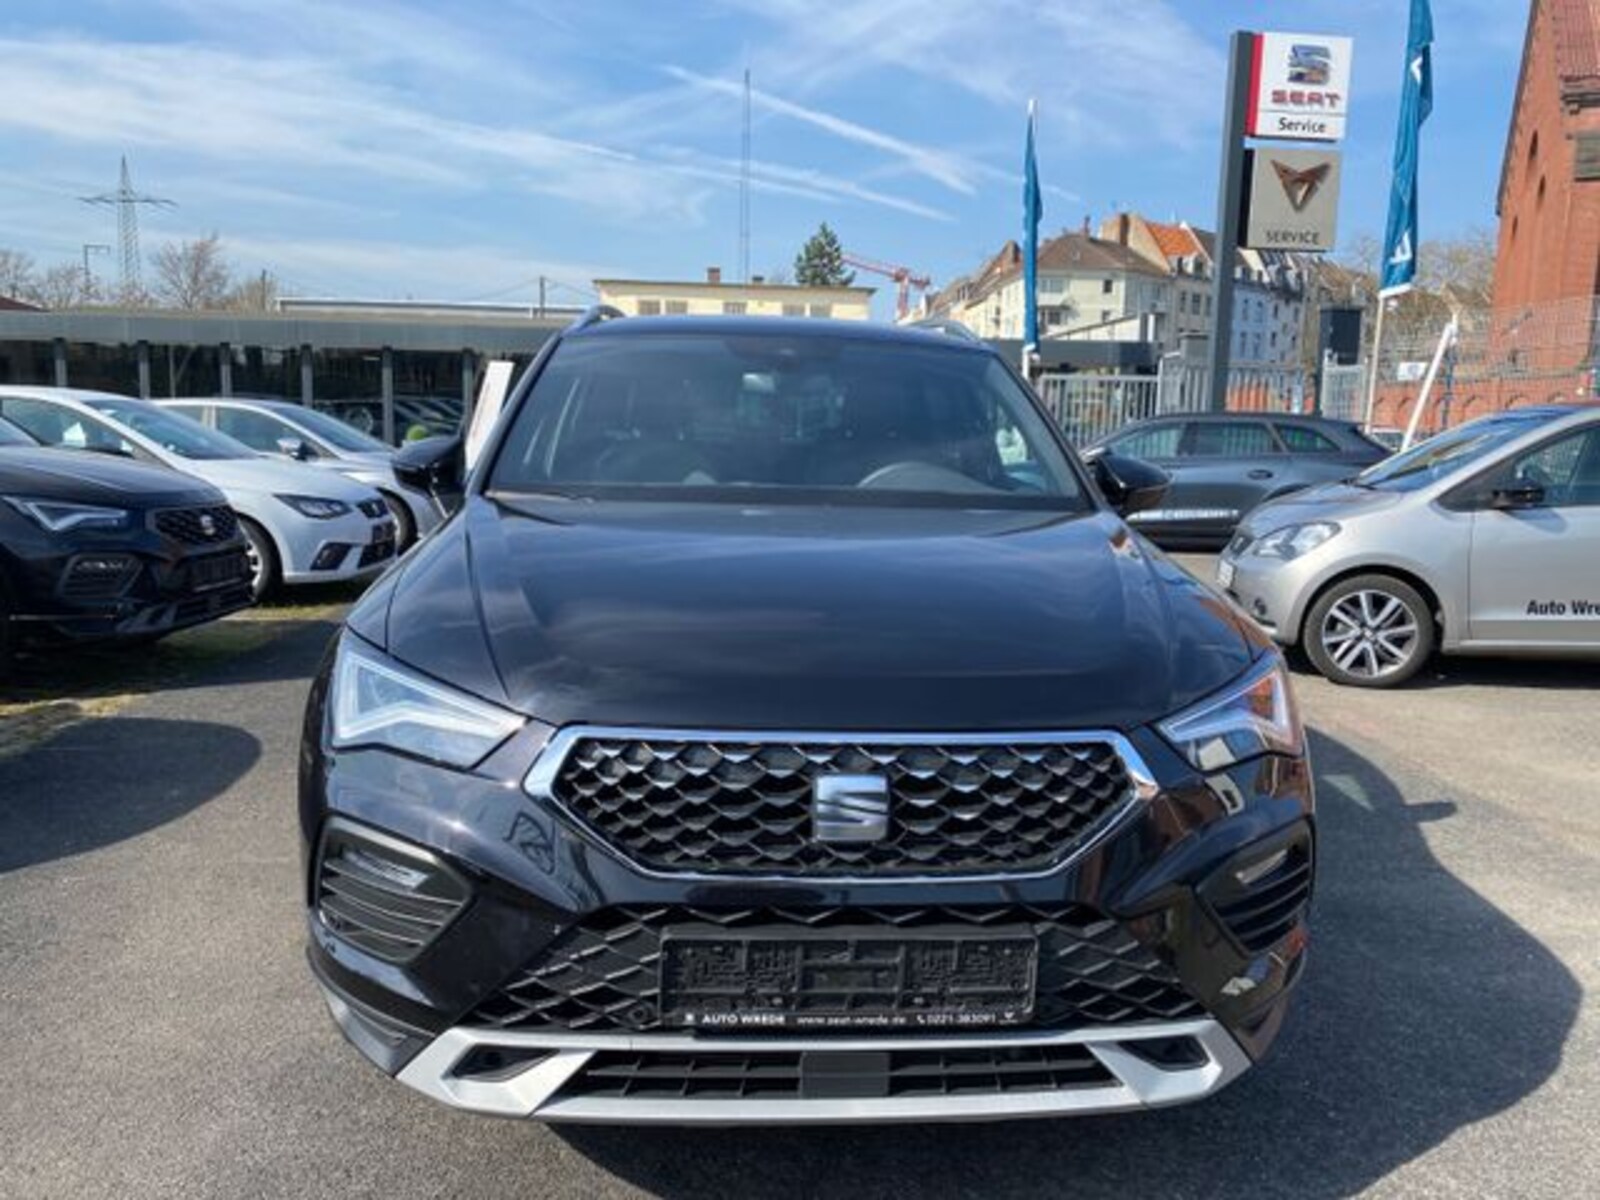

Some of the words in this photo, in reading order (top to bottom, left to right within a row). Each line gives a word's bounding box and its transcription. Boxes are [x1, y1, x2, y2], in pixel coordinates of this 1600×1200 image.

[1271, 89, 1341, 108] SEAT
[1278, 116, 1326, 133] Service
[1266, 229, 1320, 245] SERVICE
[1526, 599, 1566, 615] Auto
[702, 1013, 738, 1024] AUTO
